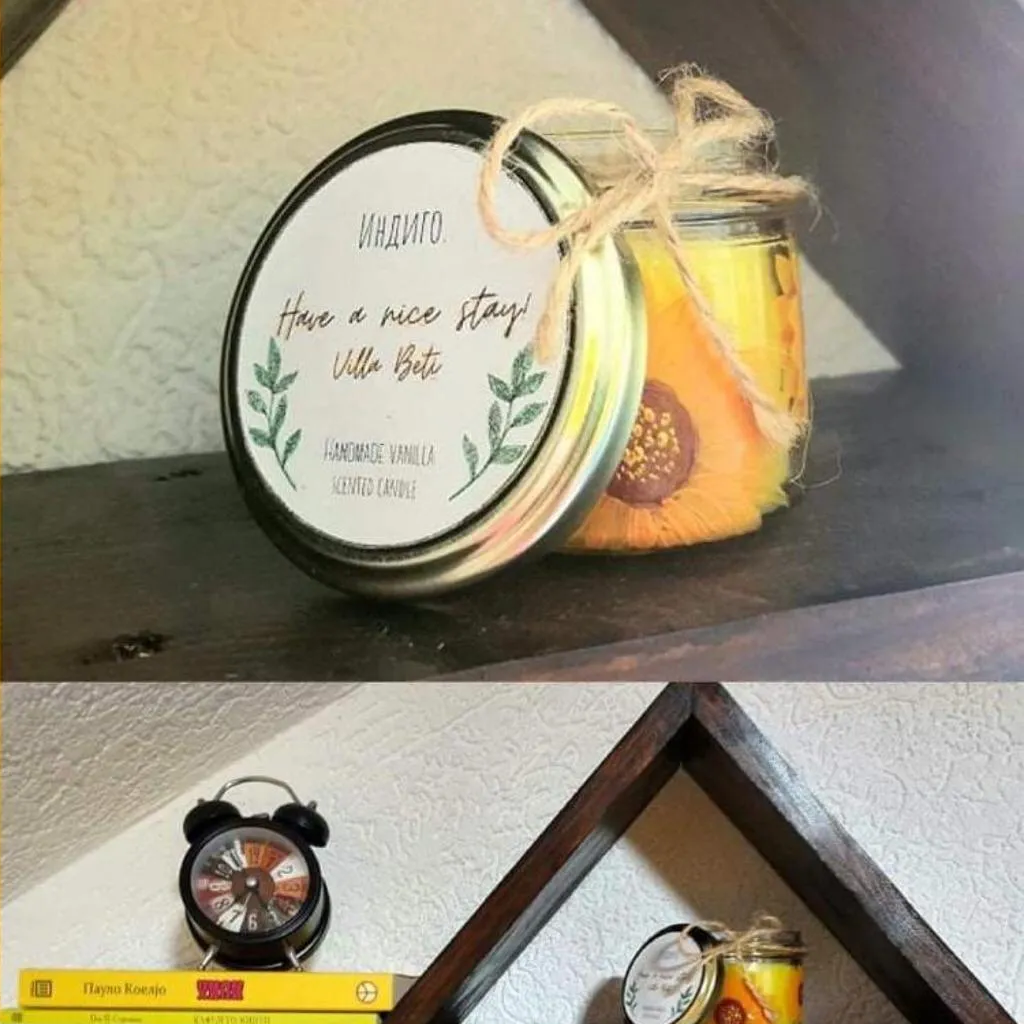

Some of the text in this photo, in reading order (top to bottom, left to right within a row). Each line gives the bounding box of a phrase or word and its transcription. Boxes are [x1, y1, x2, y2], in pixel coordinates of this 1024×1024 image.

[276, 285, 532, 340] Have a nice stay!
[332, 343, 442, 382] Villa Beti
